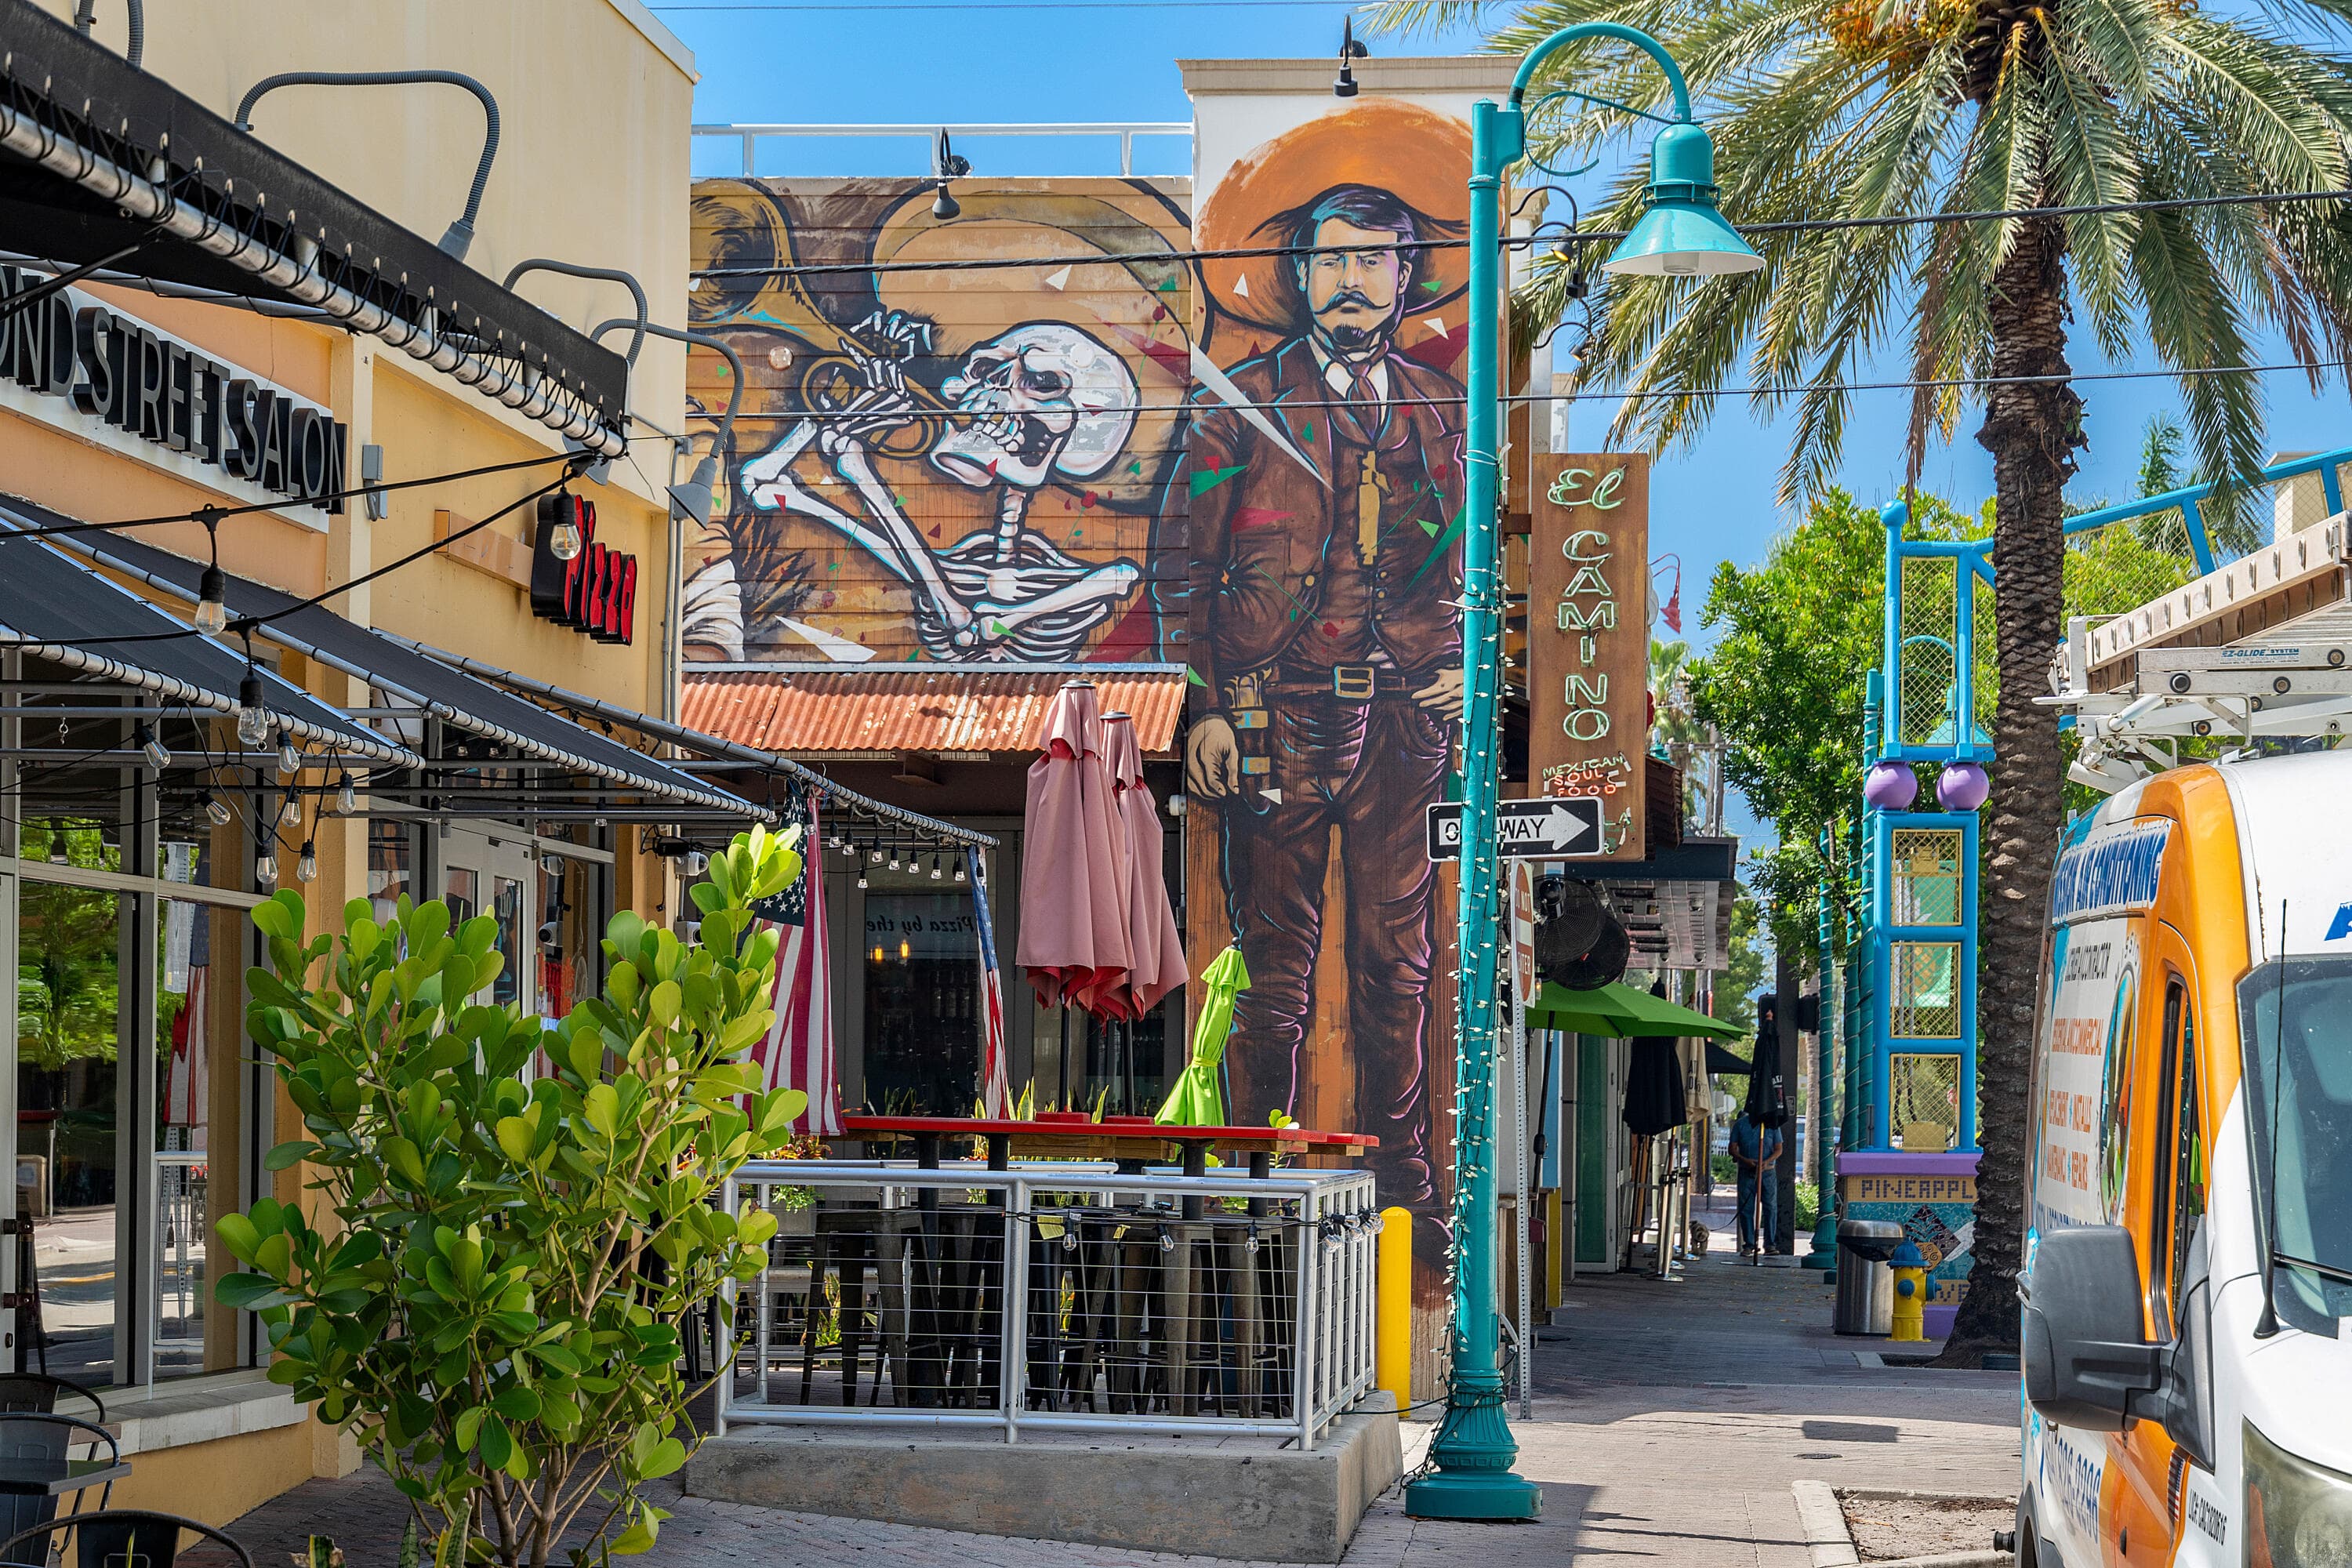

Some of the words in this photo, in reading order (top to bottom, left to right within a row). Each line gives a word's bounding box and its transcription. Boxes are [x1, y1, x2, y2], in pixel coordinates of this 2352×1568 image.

[74, 307, 230, 465] STREET
[225, 379, 347, 514] SALON
[1547, 468, 1626, 510] El
[1557, 529, 1617, 741] CAMINO
[2221, 649, 2267, 658] EZ-GLIDE
[1542, 755, 1624, 779] MEXICAN
[1553, 768, 1604, 786] SOUL
[1557, 784, 1617, 797] FOOD
[1499, 818, 1546, 840] WAY
[1861, 1179, 1974, 1199] PINEAPPL
